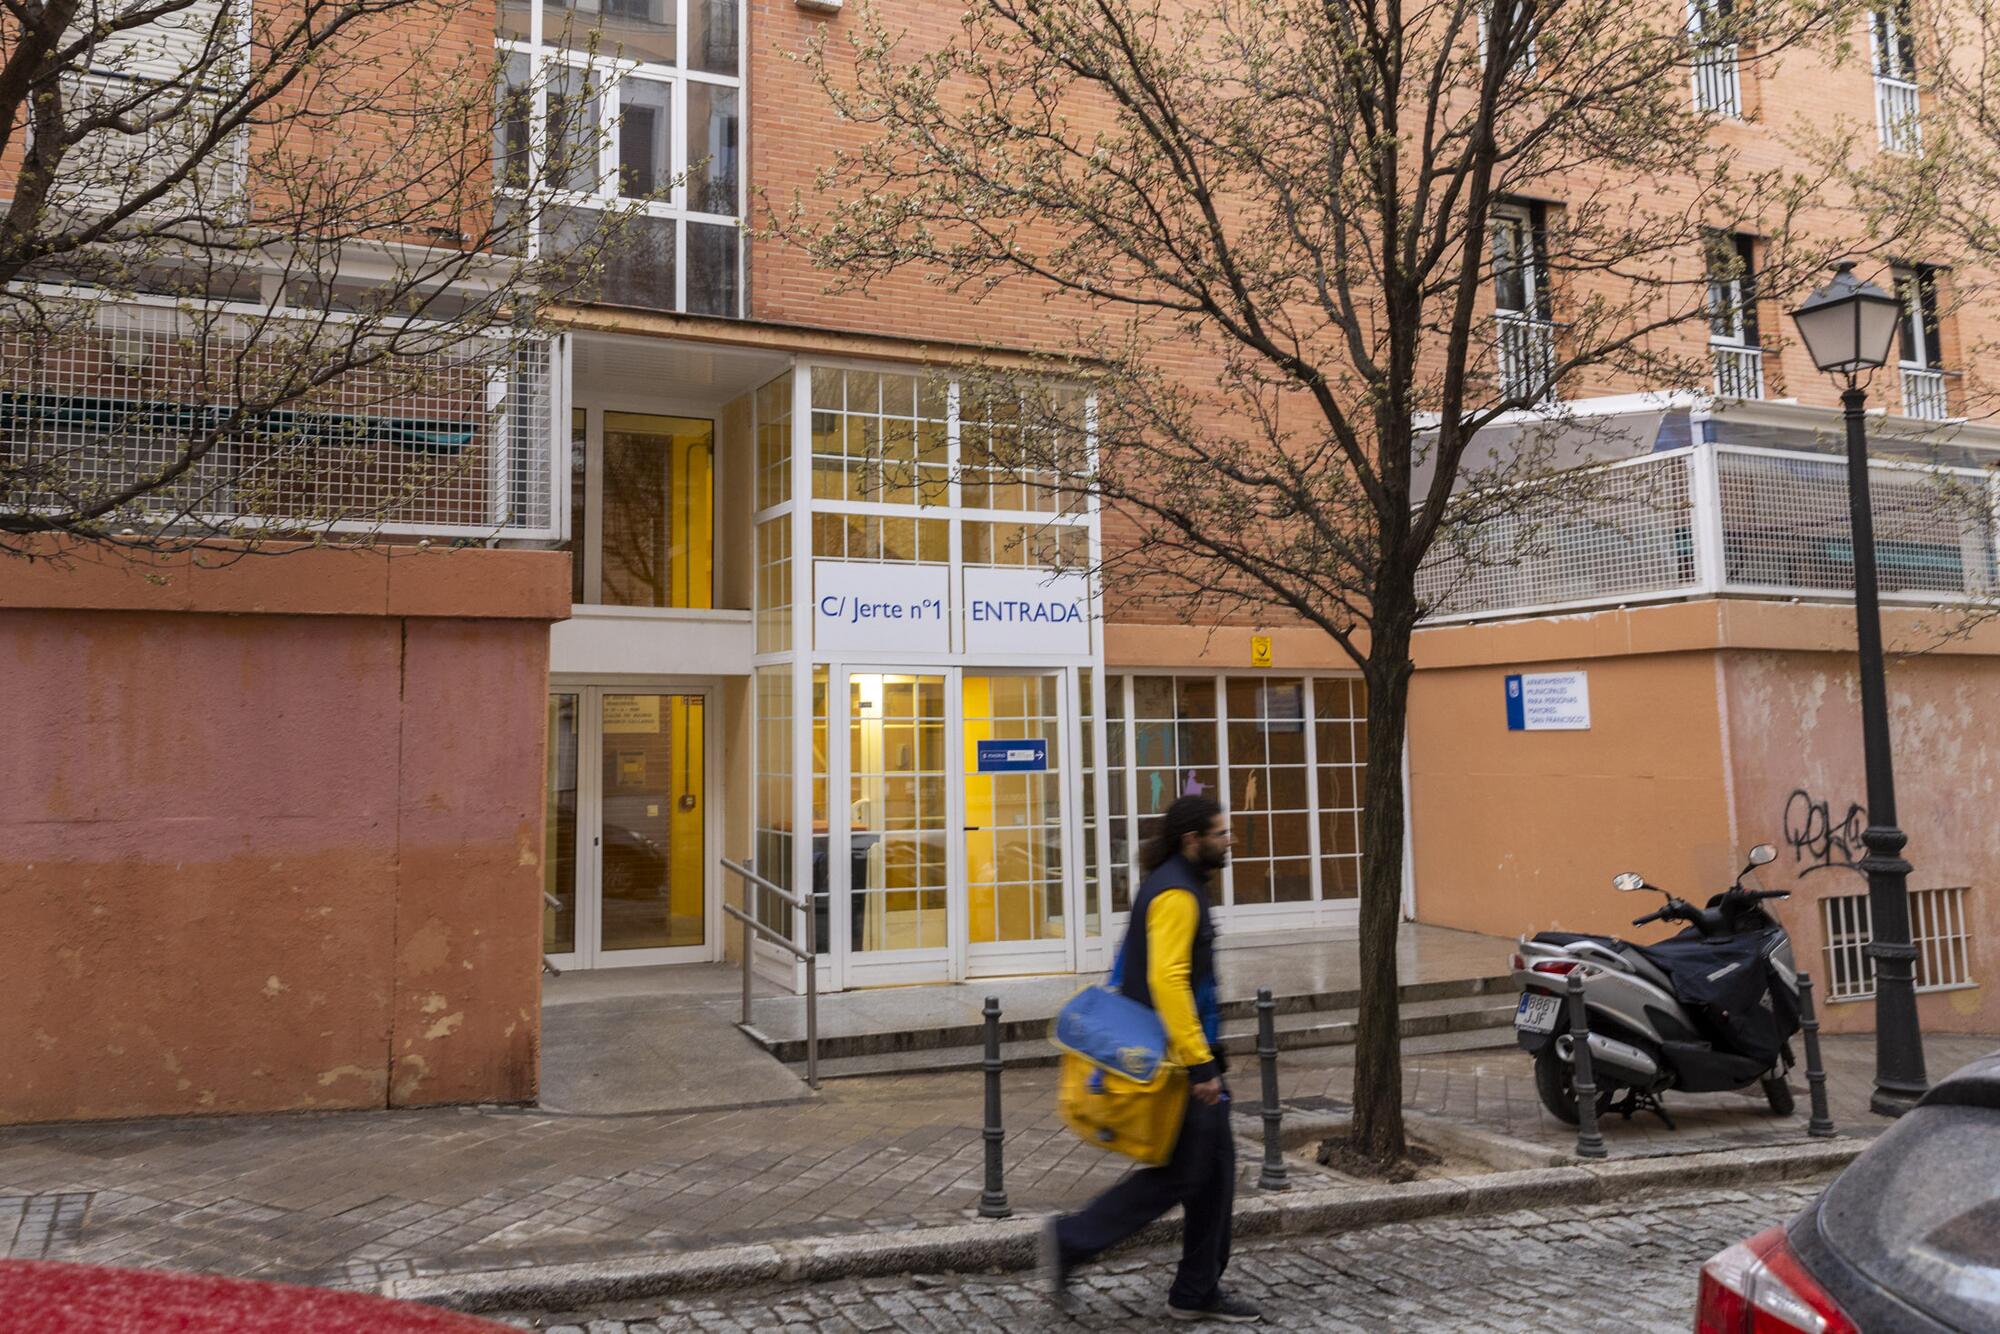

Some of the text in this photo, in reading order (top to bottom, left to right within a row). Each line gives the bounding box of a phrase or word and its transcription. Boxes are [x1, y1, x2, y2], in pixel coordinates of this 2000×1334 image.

[820, 595, 845, 618] C/
[851, 597, 903, 624] Jerte
[972, 600, 1083, 623] ENTRADA
